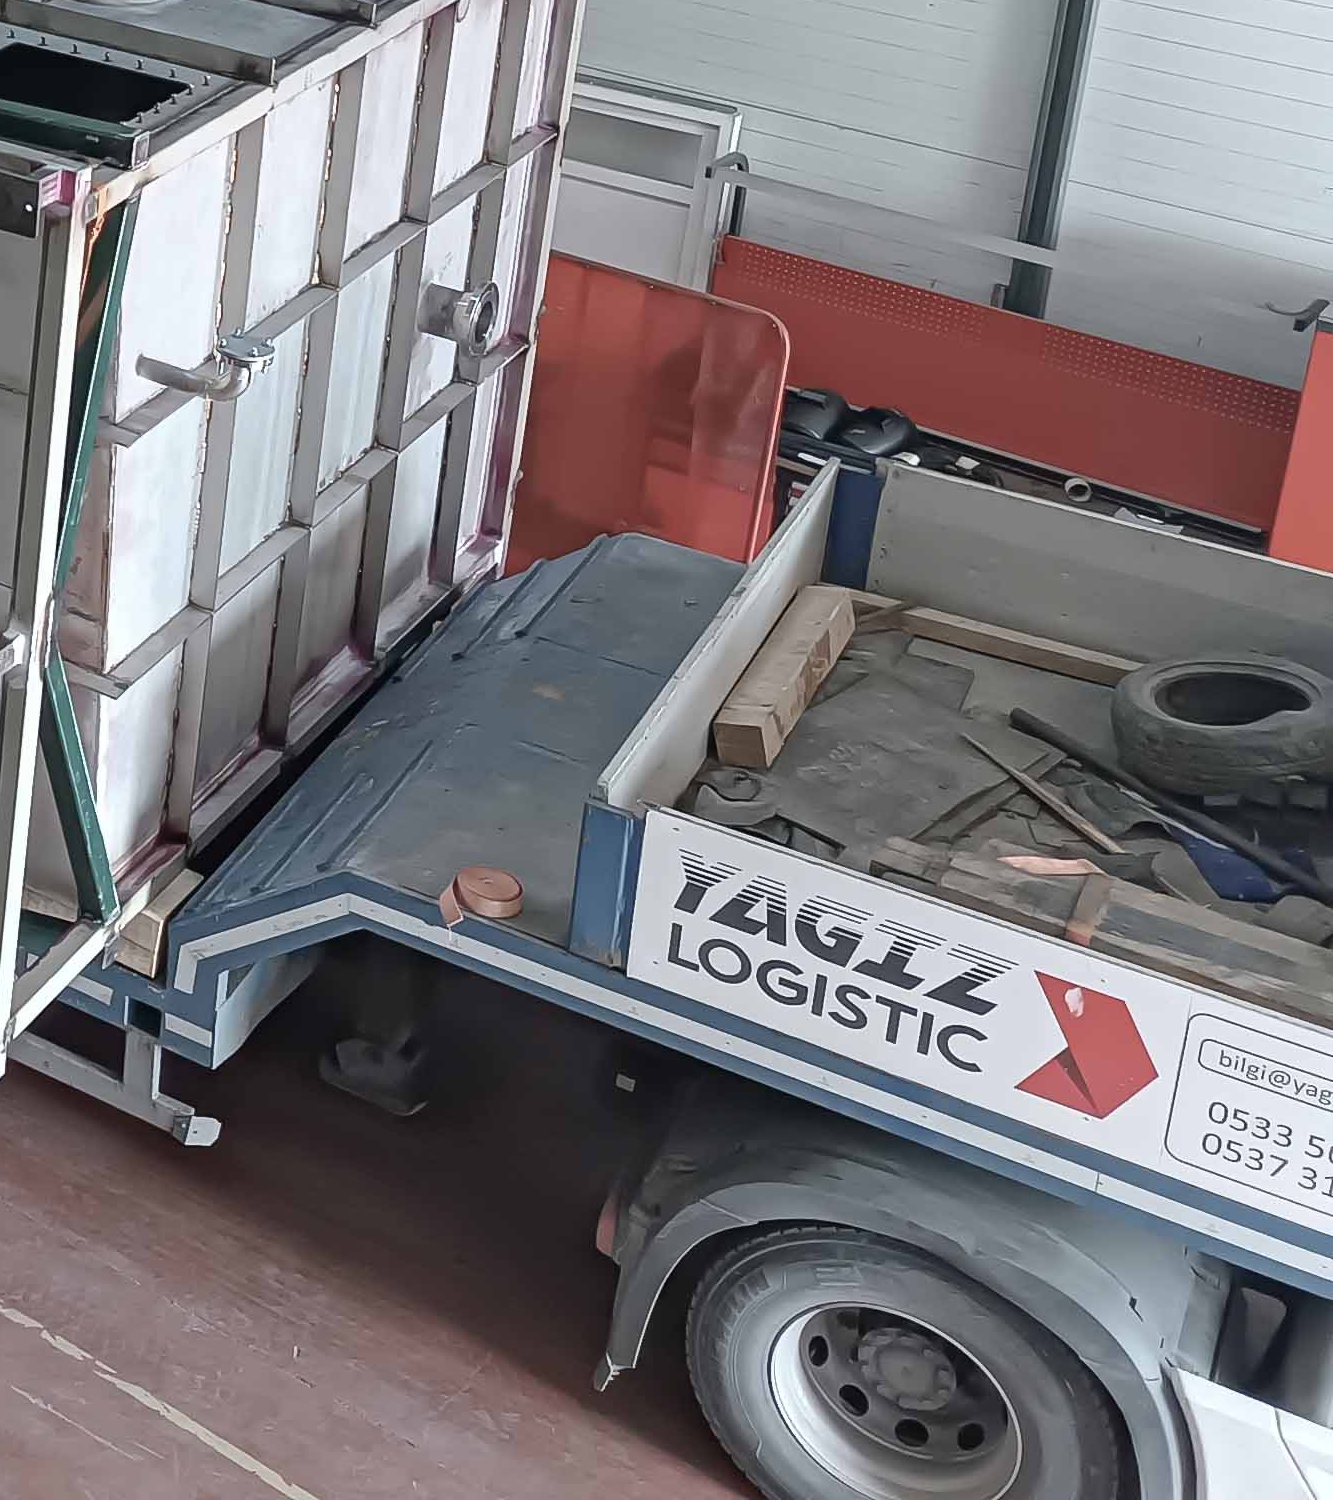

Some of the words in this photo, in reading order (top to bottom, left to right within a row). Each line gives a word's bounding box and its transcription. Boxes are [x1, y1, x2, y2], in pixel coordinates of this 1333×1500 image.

[674, 849, 1020, 1016] YAGIZ
[668, 922, 989, 1073] LOGISTIC
[1218, 1049, 1333, 1106] bilgi@yag
[1202, 1133, 1289, 1177] 0537
[1208, 1101, 1293, 1148] 0533
[1304, 1134, 1333, 1165] 5
